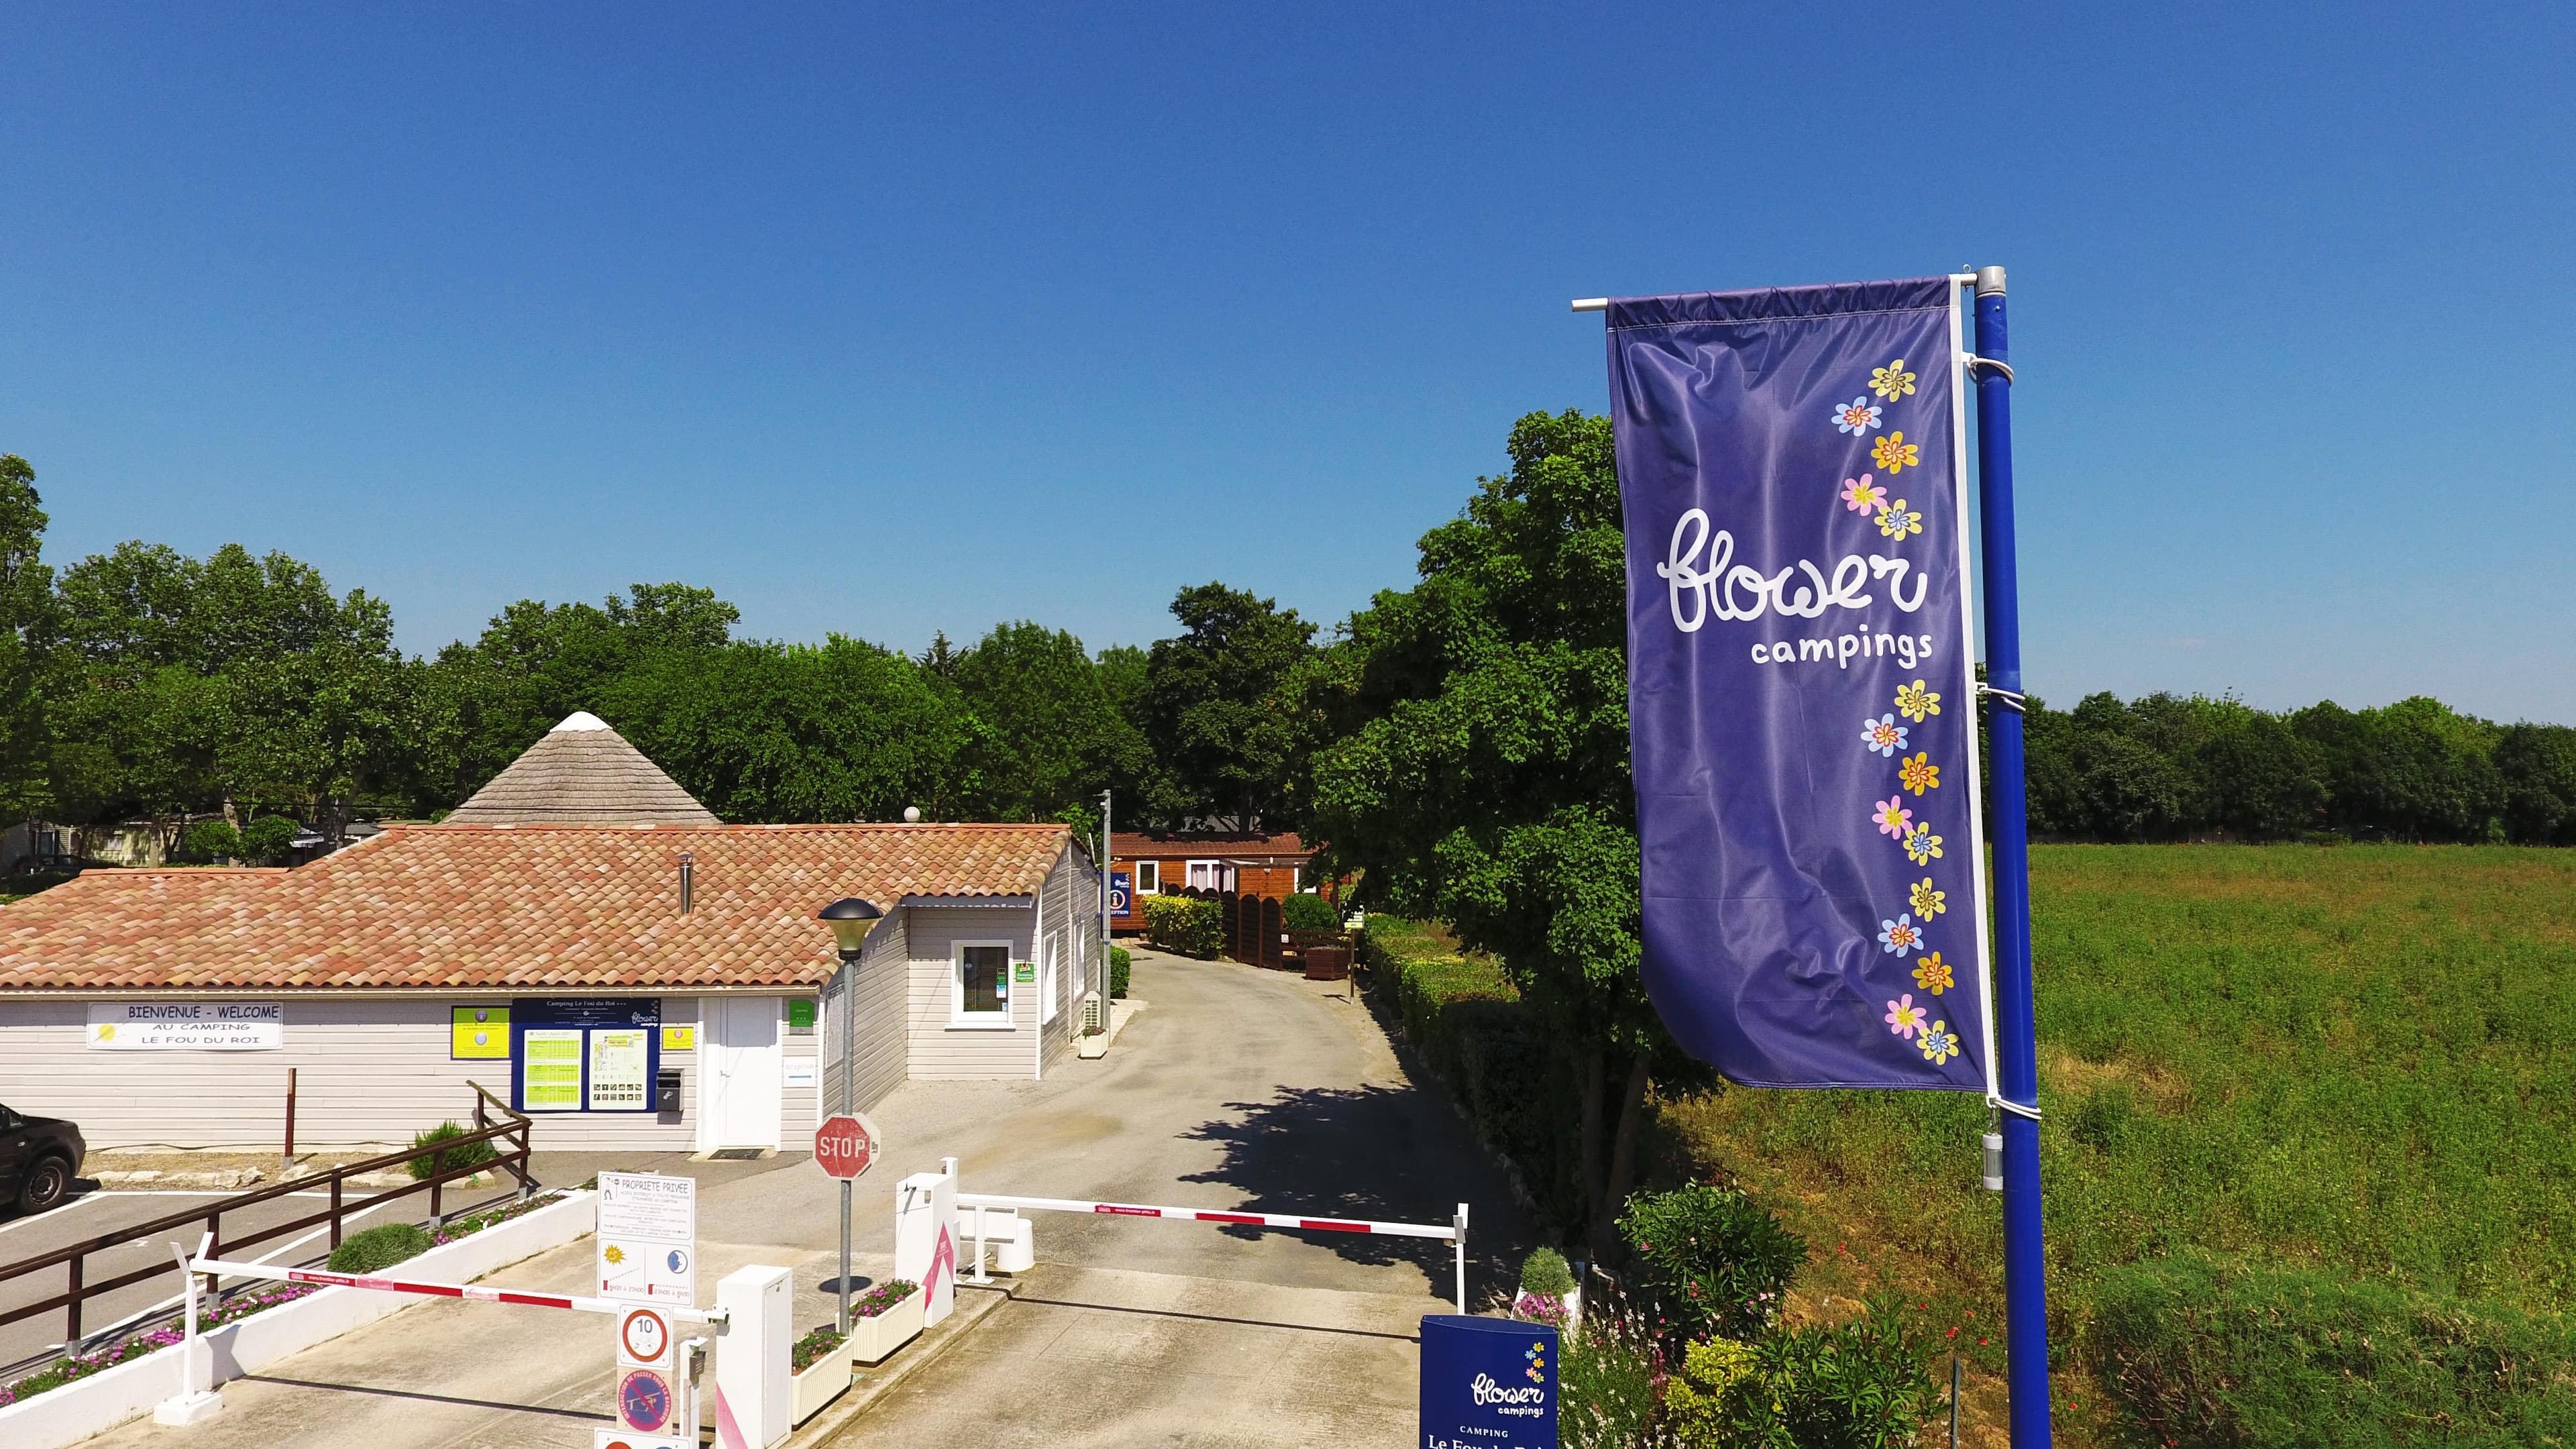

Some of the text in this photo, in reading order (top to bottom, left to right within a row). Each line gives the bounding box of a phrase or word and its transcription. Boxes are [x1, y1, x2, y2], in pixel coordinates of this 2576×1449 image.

[1657, 508, 1927, 632] flower
[1752, 624, 1932, 669] campings
[129, 1006, 201, 1019] BIENVENUE
[217, 1006, 279, 1019] WELCOME
[820, 1136, 865, 1159] STOP
[637, 1318, 653, 1334] 10
[652, 1375, 664, 1388] SOUS
[661, 1387, 668, 1396] LA
[1470, 1373, 1544, 1405] flower
[1498, 1405, 1544, 1418] campings
[1460, 1426, 1509, 1438] CAMPING
[1428, 1434, 1448, 1449] Le
